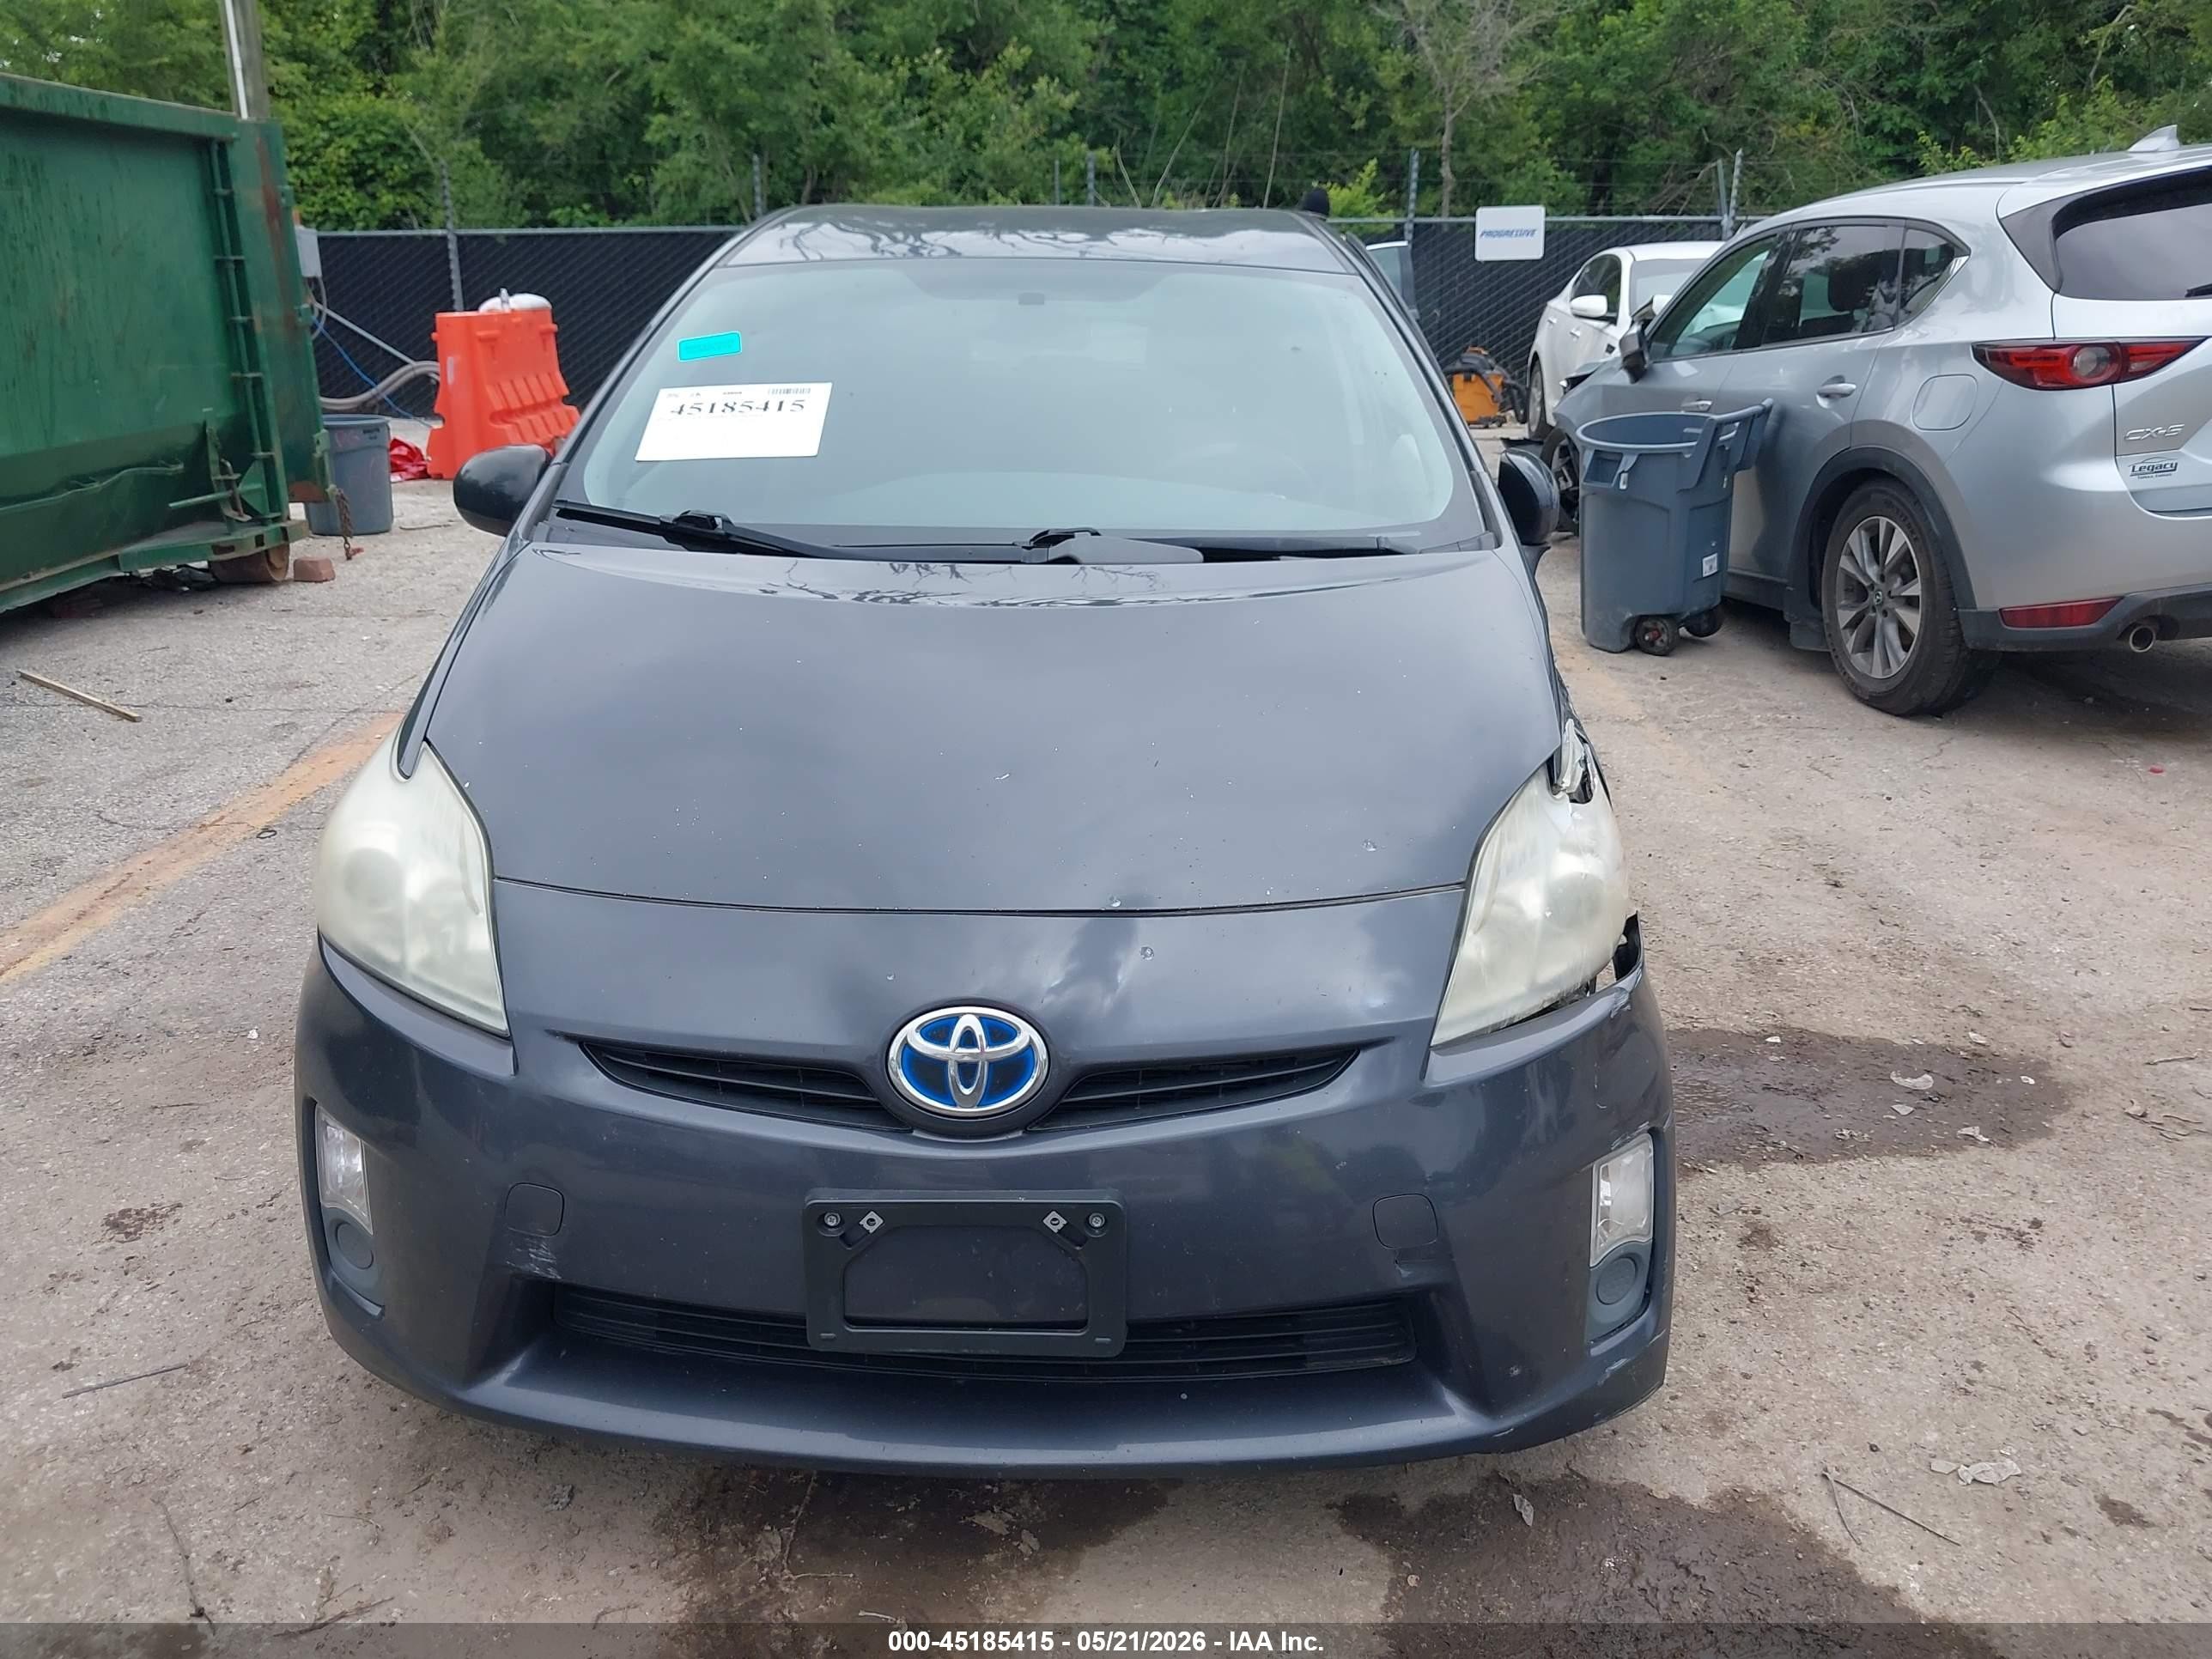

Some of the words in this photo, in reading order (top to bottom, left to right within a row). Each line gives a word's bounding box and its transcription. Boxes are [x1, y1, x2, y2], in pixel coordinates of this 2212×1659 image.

[671, 398, 806, 416] 45185415
[2124, 423, 2185, 441] CX-5
[2130, 462, 2179, 475] Legacy
